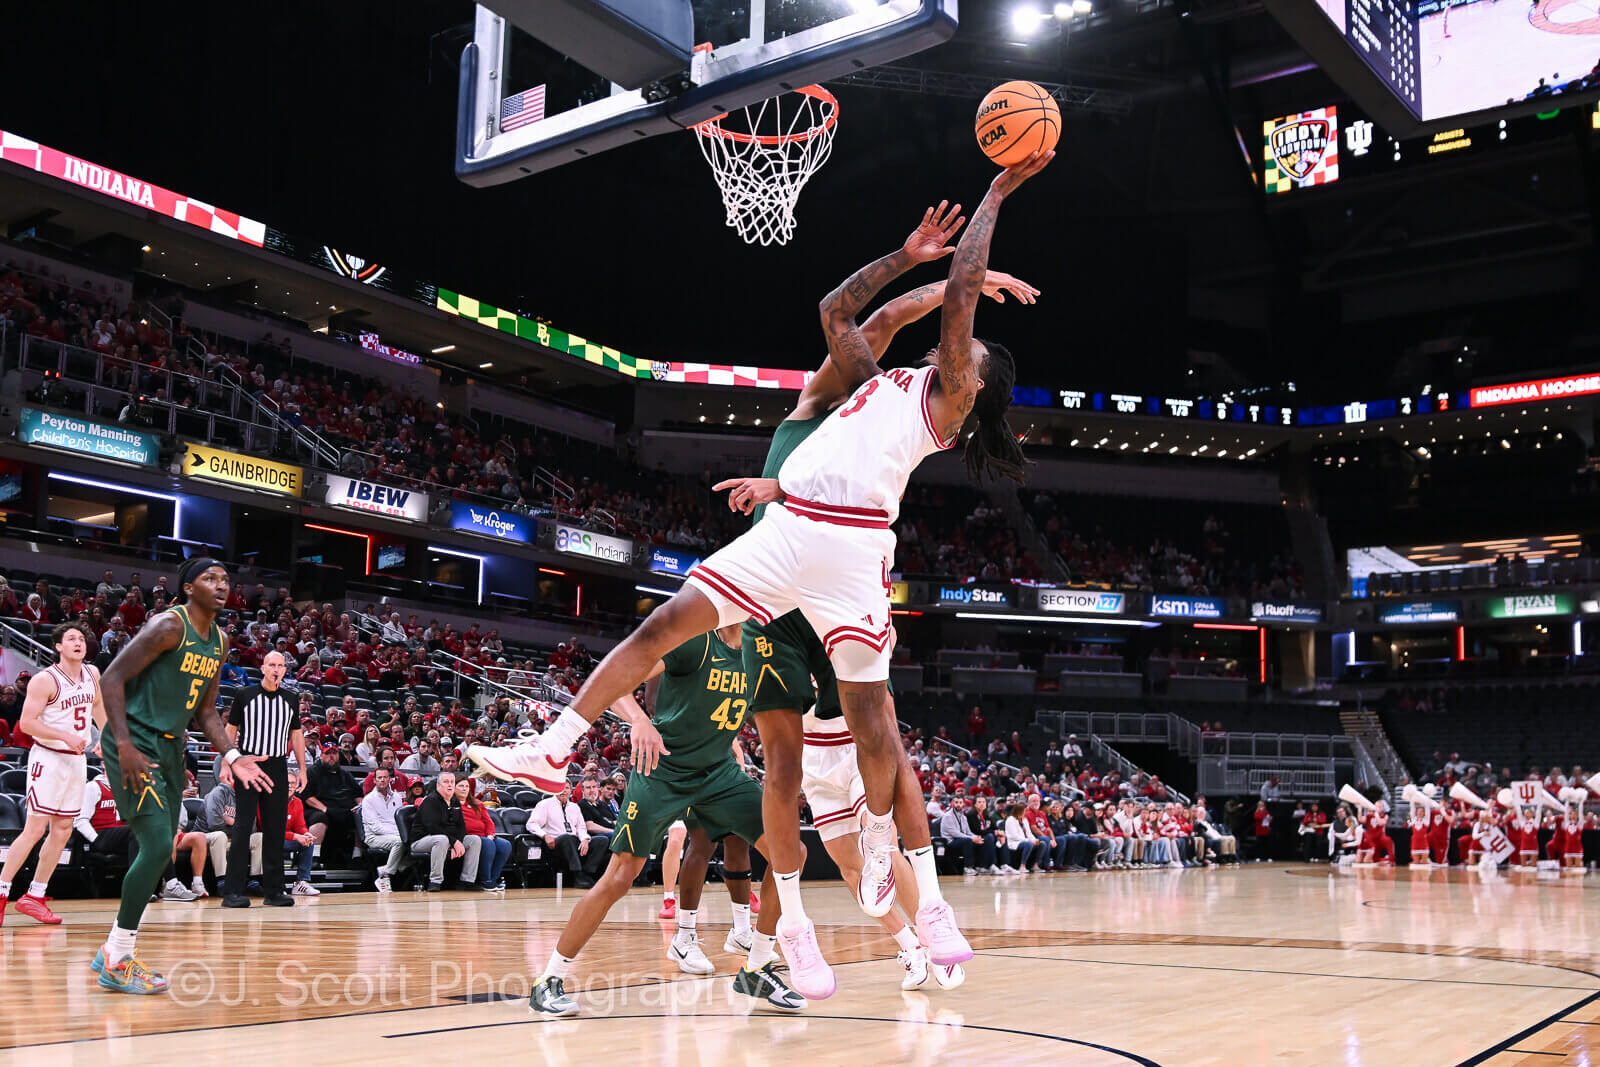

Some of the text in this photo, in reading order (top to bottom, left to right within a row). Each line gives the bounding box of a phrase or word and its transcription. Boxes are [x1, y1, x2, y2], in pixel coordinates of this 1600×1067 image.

[979, 124, 1007, 148] NCAA
[1275, 138, 1327, 157] SHOWDOWN
[1277, 124, 1322, 147] INDY
[64, 156, 155, 208] INDIANA
[840, 379, 879, 418] 3
[1476, 384, 1539, 403] INDIANA
[41, 413, 142, 447] Peyton Manning
[32, 429, 148, 463] Children's Hospital
[210, 456, 297, 489] GAINBRIDGE
[347, 480, 410, 508] IBEW
[484, 511, 515, 537] Kroger
[556, 528, 631, 564] aes Indiana
[653, 553, 679, 565] Elevance
[1040, 595, 1096, 606] SECTION
[1152, 595, 1189, 615] ksm
[1265, 604, 1294, 616] Ruoff
[1514, 594, 1556, 608] RYAN
[755, 636, 773, 658] BU
[180, 651, 220, 680] BEARS
[186, 678, 205, 710] 5
[74, 706, 87, 731] 5
[710, 697, 748, 731] 43
[31, 761, 44, 781] IU
[626, 800, 639, 820] BU
